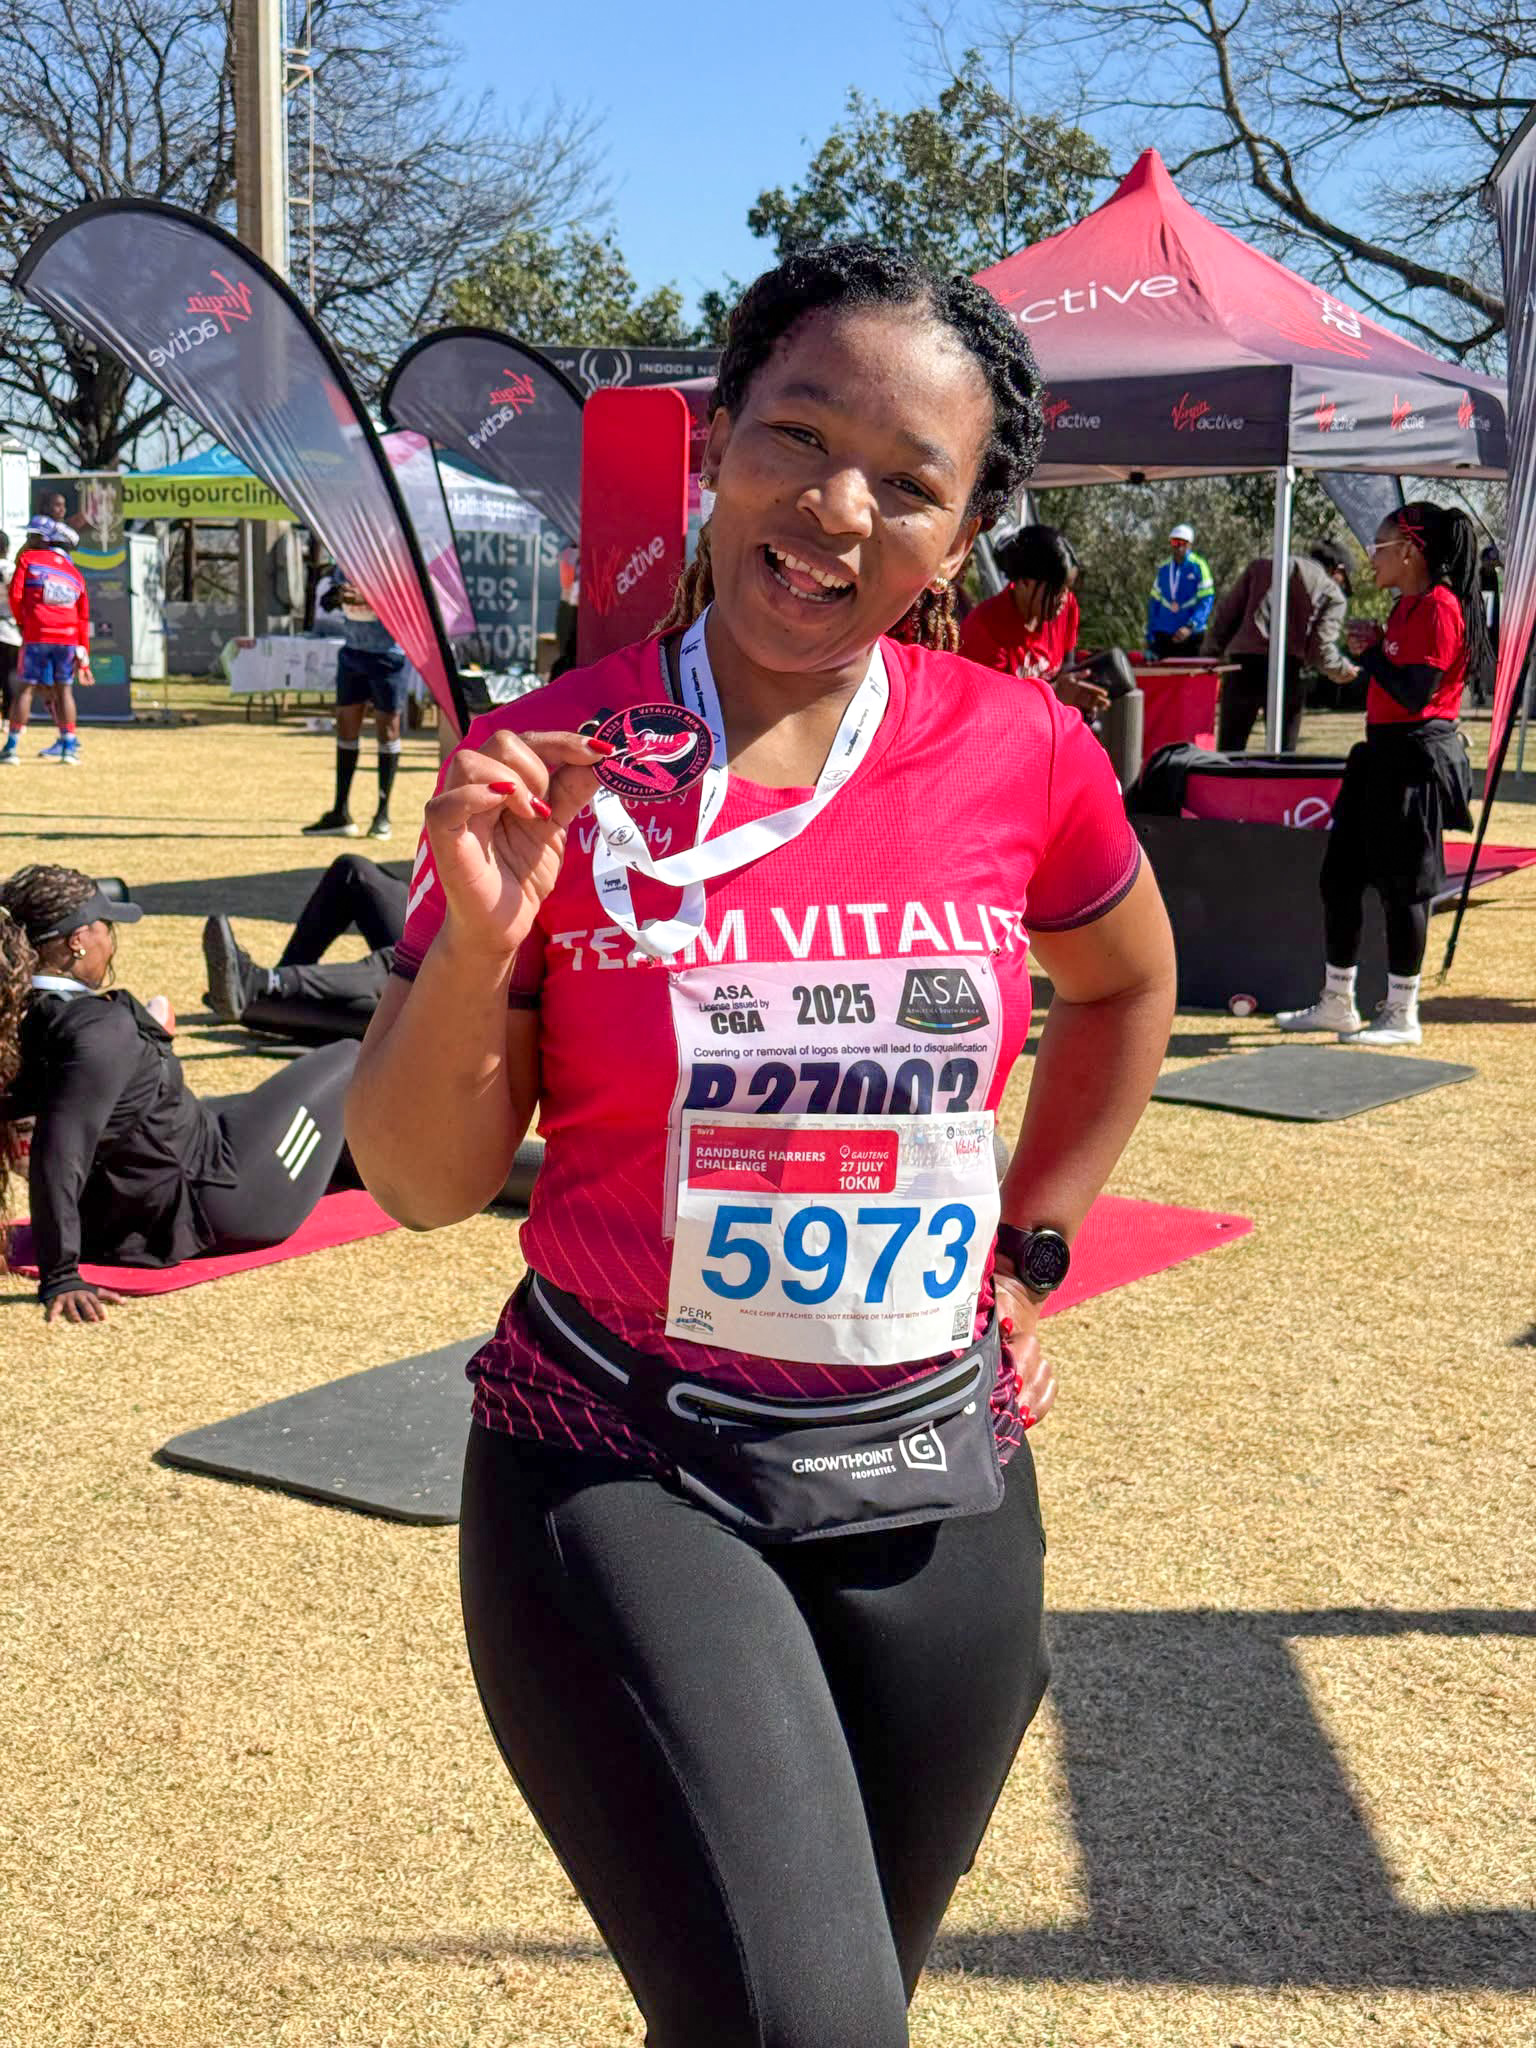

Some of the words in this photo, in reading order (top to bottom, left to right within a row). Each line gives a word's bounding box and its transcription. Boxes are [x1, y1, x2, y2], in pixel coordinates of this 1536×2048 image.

[1009, 274, 1179, 324] ctive
[1056, 412, 1101, 430] active
[1196, 413, 1245, 430] active
[459, 531, 560, 568] CKETS
[615, 535, 666, 595] active
[713, 984, 754, 1001] ASA
[908, 975, 977, 1005] ASA
[698, 1001, 731, 1013] License
[732, 999, 759, 1010] issued
[759, 998, 770, 1010] by
[792, 983, 876, 1026] 2025
[710, 1010, 766, 1035] CGA
[693, 1046, 741, 1060] Covering
[743, 1048, 754, 1058] or
[756, 1045, 797, 1057] removal
[799, 1044, 810, 1056] of
[811, 1044, 839, 1059] logos
[840, 1044, 871, 1056] above
[873, 1042, 889, 1054] will
[890, 1042, 911, 1054] lead
[913, 1042, 922, 1053] to
[923, 1042, 988, 1056] disqualification
[695, 1146, 766, 1161] RANDBURG
[768, 1150, 826, 1163] HARRIERS
[851, 1151, 890, 1160] GAUTENG
[695, 1159, 768, 1173] CHALLENGE
[839, 1161, 855, 1172] 27
[855, 1161, 884, 1175] JULY
[838, 1175, 881, 1191] 10KM
[701, 1203, 976, 1306] 5973
[679, 1305, 713, 1321] PEAK
[739, 1308, 757, 1317] RACE
[759, 1309, 776, 1318] CHIP
[881, 1312, 905, 1320] TAMPER
[851, 1464, 897, 1480] PROPERTIES
